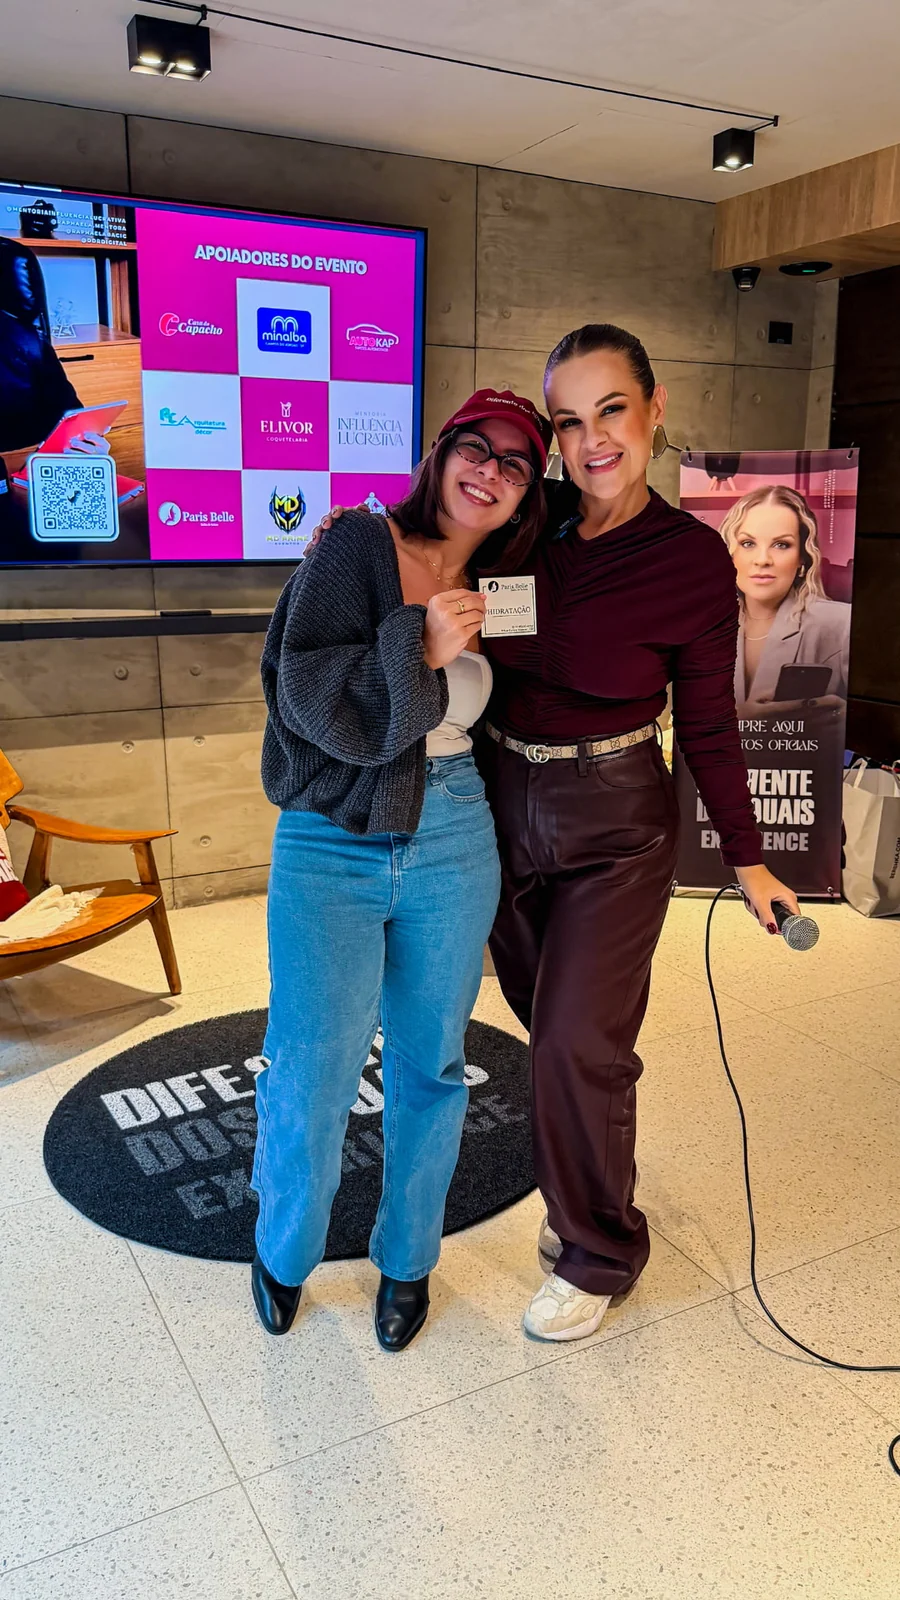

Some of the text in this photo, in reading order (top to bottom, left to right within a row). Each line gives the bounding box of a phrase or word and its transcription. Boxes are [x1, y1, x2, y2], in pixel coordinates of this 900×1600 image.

[194, 245, 367, 275] APOIADORES DO EVENTO
[178, 322, 223, 336] Capacho
[262, 330, 307, 343] minalba
[349, 335, 395, 348] AUTOKAP
[260, 419, 314, 435] ELIVOR
[338, 417, 403, 432] INFLUÊNCIA
[338, 431, 404, 447] LUCRATIVA
[182, 511, 235, 523] Paris Belle
[487, 605, 531, 615] HIDRATAÇÃO
[772, 720, 804, 735] AQUI
